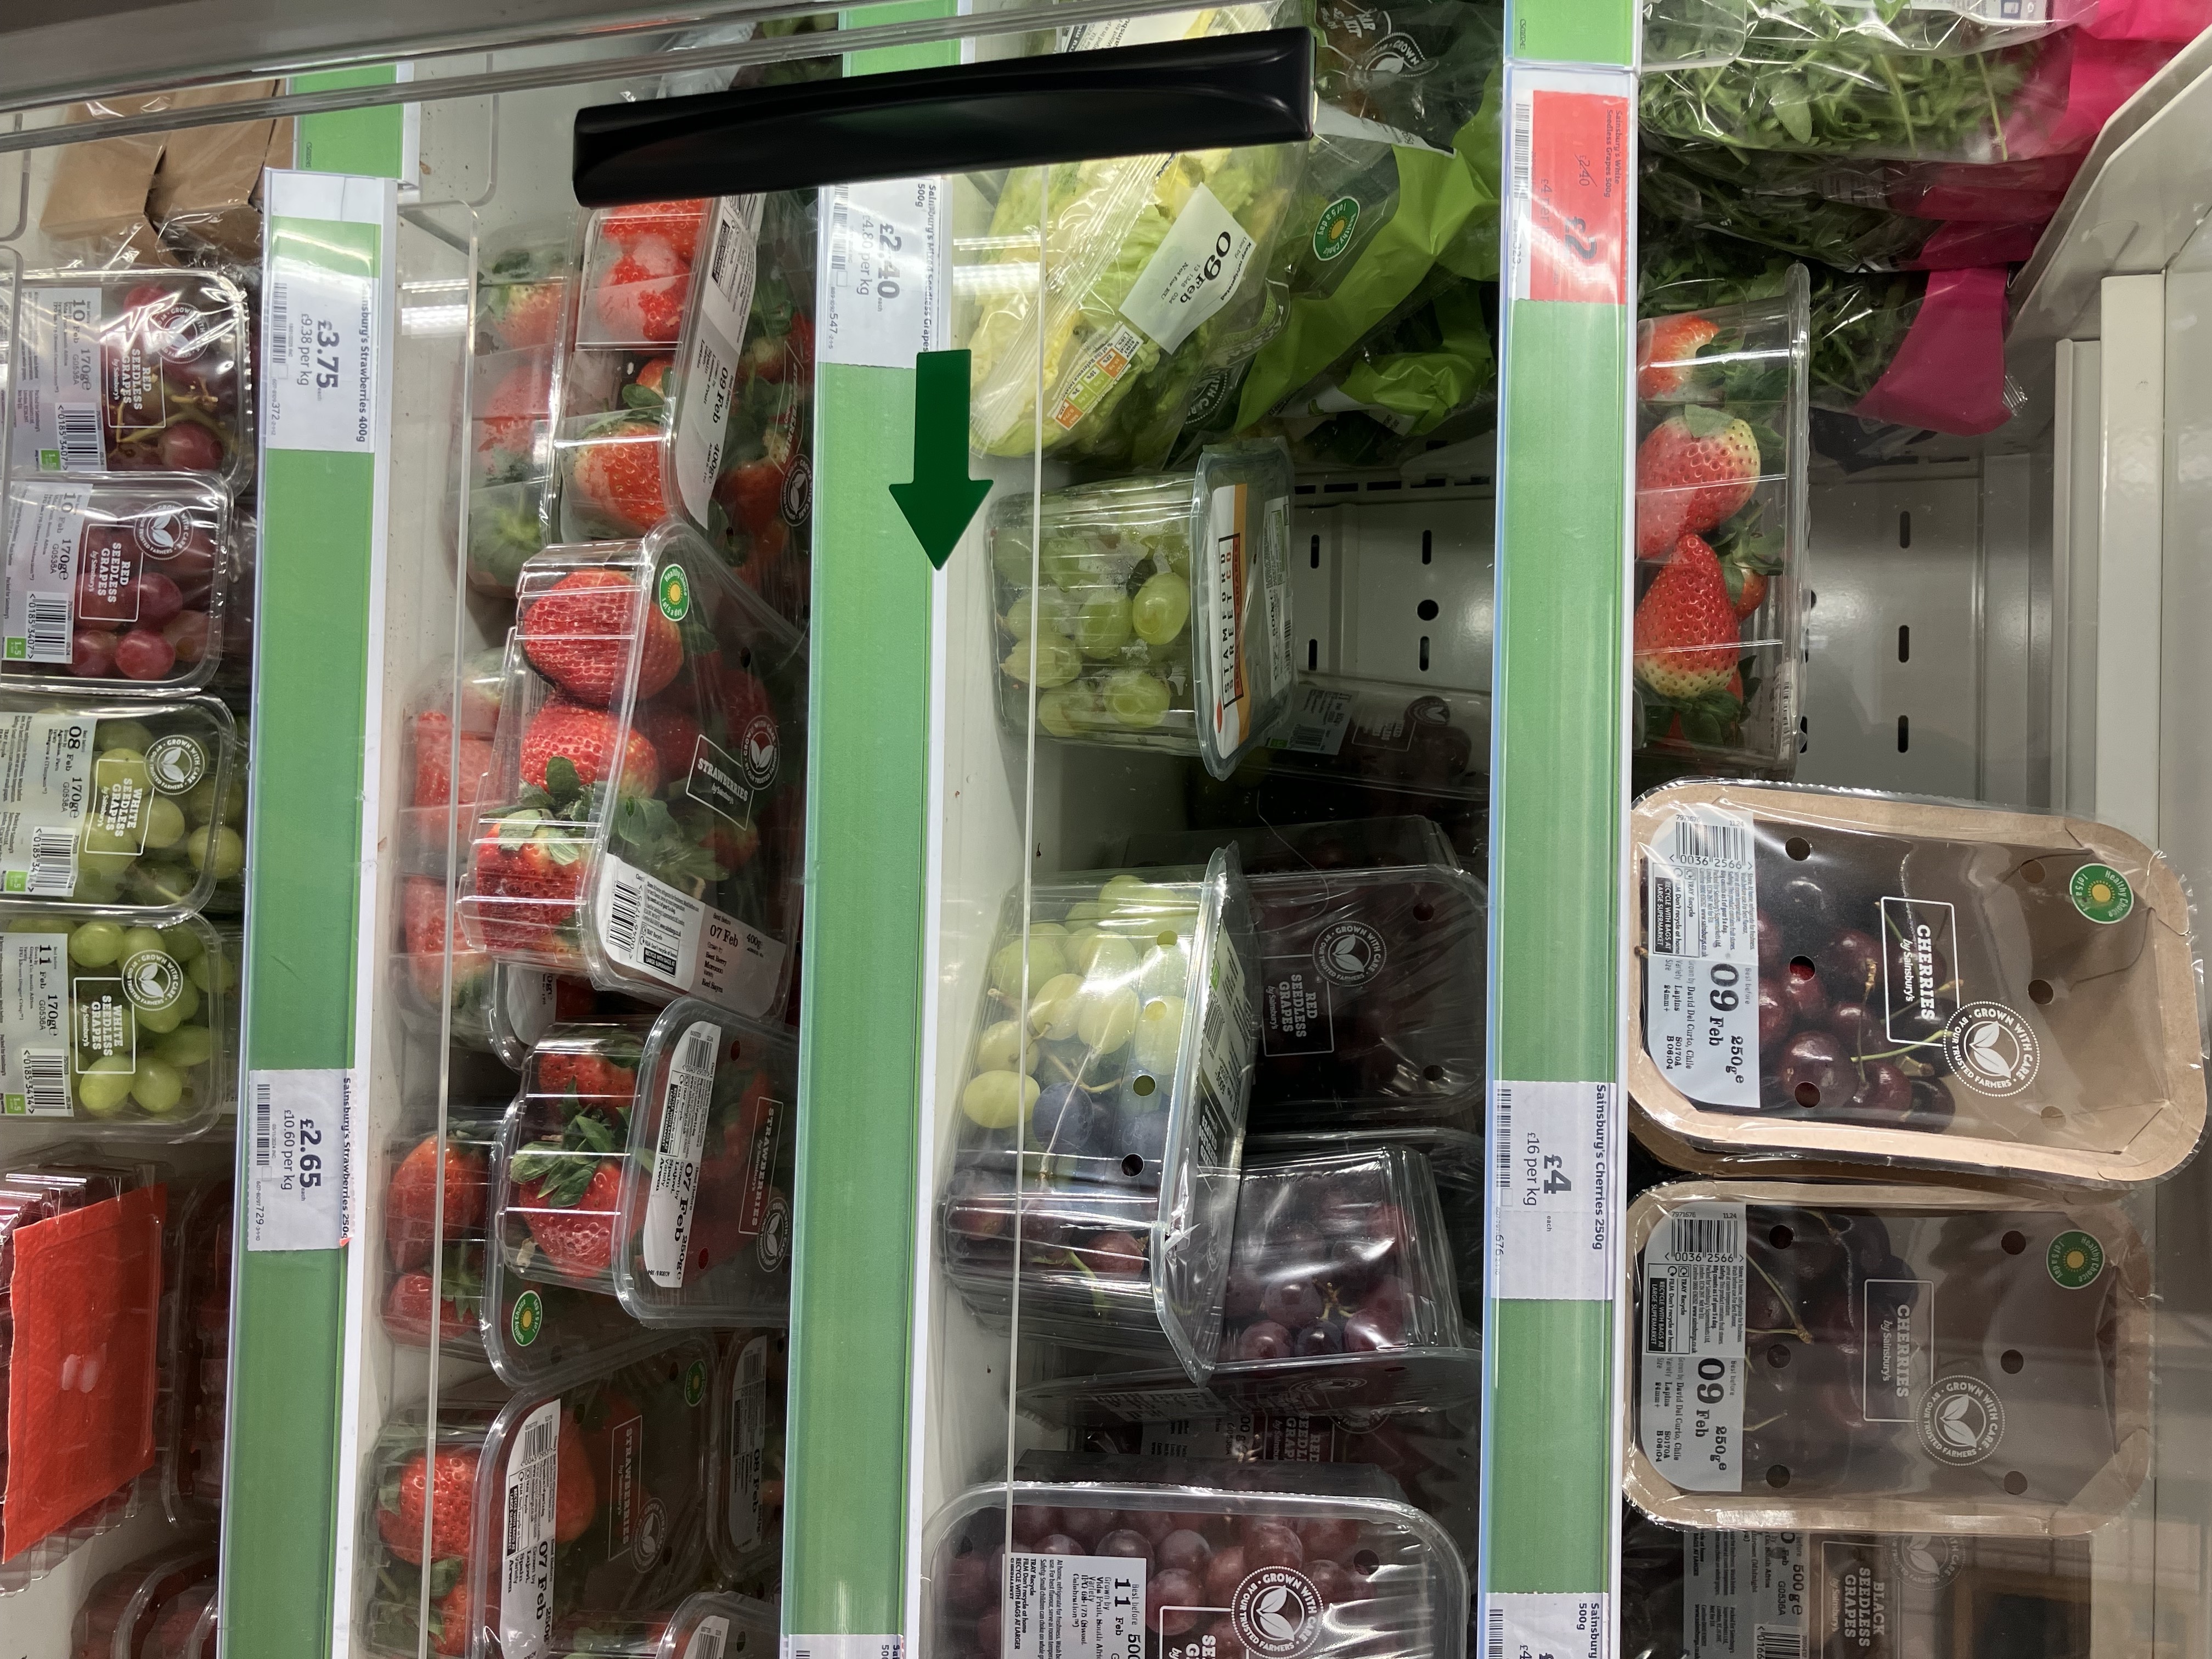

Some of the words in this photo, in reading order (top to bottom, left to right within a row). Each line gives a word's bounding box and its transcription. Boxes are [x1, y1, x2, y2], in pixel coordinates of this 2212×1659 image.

[1614, 110, 1623, 157] Sainsbury's
[916, 184, 925, 207] 500g
[1541, 178, 1552, 193] £4
[1242, 242, 1251, 259] Keep
[1565, 216, 1597, 259] £2
[859, 253, 871, 275] per
[878, 223, 901, 299] £2.40
[1177, 262, 1188, 275] Not
[1204, 232, 1231, 280] 09
[857, 279, 872, 295] kg
[924, 274, 933, 315] Seedless
[1161, 287, 1170, 300] EU
[1169, 276, 1179, 287] for
[1180, 273, 1205, 303] Feb
[1220, 261, 1243, 301] refrigerated
[73, 300, 86, 321] 10
[359, 283, 370, 343] Sainsbury's
[301, 314, 312, 343] £9.38
[922, 318, 931, 352] Grapes
[298, 347, 310, 368] per
[317, 320, 340, 388] £3.75
[132, 349, 142, 409] SEEDLESS
[142, 367, 151, 392] RED
[297, 371, 312, 385] kg
[359, 346, 369, 413] Strawberries
[58, 414, 66, 435] 0185
[357, 416, 367, 442] 400g
[98, 549, 111, 596] GRAPES
[107, 543, 121, 602] SEEDLESS
[121, 561, 131, 585] RED
[68, 726, 82, 749] 08
[698, 758, 748, 802] STRAWBERRIES
[127, 788, 142, 828] WHITE
[40, 945, 52, 965] 11
[1900, 939, 1913, 951] by
[1674, 960, 1682, 980] Variety
[1903, 952, 1915, 1002] Sainsbury's
[1917, 924, 1935, 1020] CHERRIES
[1672, 985, 1681, 1011] Lapins
[1710, 963, 1739, 1012] 09
[81, 1005, 89, 1013] by
[1279, 981, 1294, 1031] GRAPES
[1291, 974, 1307, 1037] SEEDLESS
[1306, 992, 1317, 1019] RED
[1974, 1008, 2015, 1026] GROWN
[92, 1001, 101, 1049] GRAPES
[102, 996, 112, 1056] SEEDLESS
[113, 1005, 123, 1046] WHITE
[1709, 1016, 1724, 1046] Feb
[1952, 1026, 1961, 1044] OUR
[1959, 1017, 1968, 1028] BY
[2015, 1023, 2032, 1051] WITH
[24, 1059, 32, 1080] 0185
[1952, 1045, 1974, 1078] TRUSTED
[2016, 1054, 2033, 1080] CARE
[26, 1084, 35, 1105] 3414
[1974, 1076, 2012, 1088] FARMERS
[341, 1078, 351, 1139] Sainsbury's
[1594, 1085, 1606, 1158] Sainsbury's
[284, 1110, 295, 1147] £10.60
[300, 1119, 321, 1187] £2.65
[1527, 1132, 1539, 1154] £16
[281, 1151, 292, 1171] per
[752, 1108, 774, 1226] STRAWBERRIES
[1523, 1158, 1537, 1183] per
[1544, 1154, 1572, 1194] £4
[281, 1175, 295, 1190] kg
[342, 1142, 351, 1211] Strawberries
[683, 1163, 693, 1192] 07
[1595, 1163, 1605, 1215] Cherries
[1523, 1188, 1539, 1206] kg
[675, 1197, 689, 1242] Feb
[1592, 1218, 1604, 1250] 250g
[1881, 1320, 1893, 1332] by
[1881, 1333, 1891, 1381] Sainsbury's
[1896, 1305, 1910, 1397] CHERRIES
[1663, 1382, 1672, 1407] Lapins
[1697, 1358, 1725, 1404] 09
[1946, 1382, 1984, 1397] GROWN
[1983, 1394, 1998, 1420] WITH
[1696, 1409, 1709, 1437] Feb
[1981, 1423, 1997, 1448] CARE
[623, 1427, 633, 1544] STRAWBERRIES
[539, 1542, 548, 1567] 07
[1248, 1583, 1257, 1594] BY
[1263, 1573, 1302, 1589] GROWN
[537, 1573, 547, 1620] Feb
[1240, 1593, 1250, 1610] OUR
[1300, 1586, 1317, 1613] WITH
[1844, 1575, 1856, 1638] GRAPES
[1859, 1567, 1870, 1646] SEEDLESS
[1873, 1581, 1884, 1635] BLACK
[1115, 1617, 1124, 1635] Feb
[1240, 1612, 1259, 1644] TRUSTED
[1299, 1617, 1317, 1642] CARE
[1577, 1603, 1587, 1630] 500g
[1259, 1641, 1295, 1651] FARMERS
